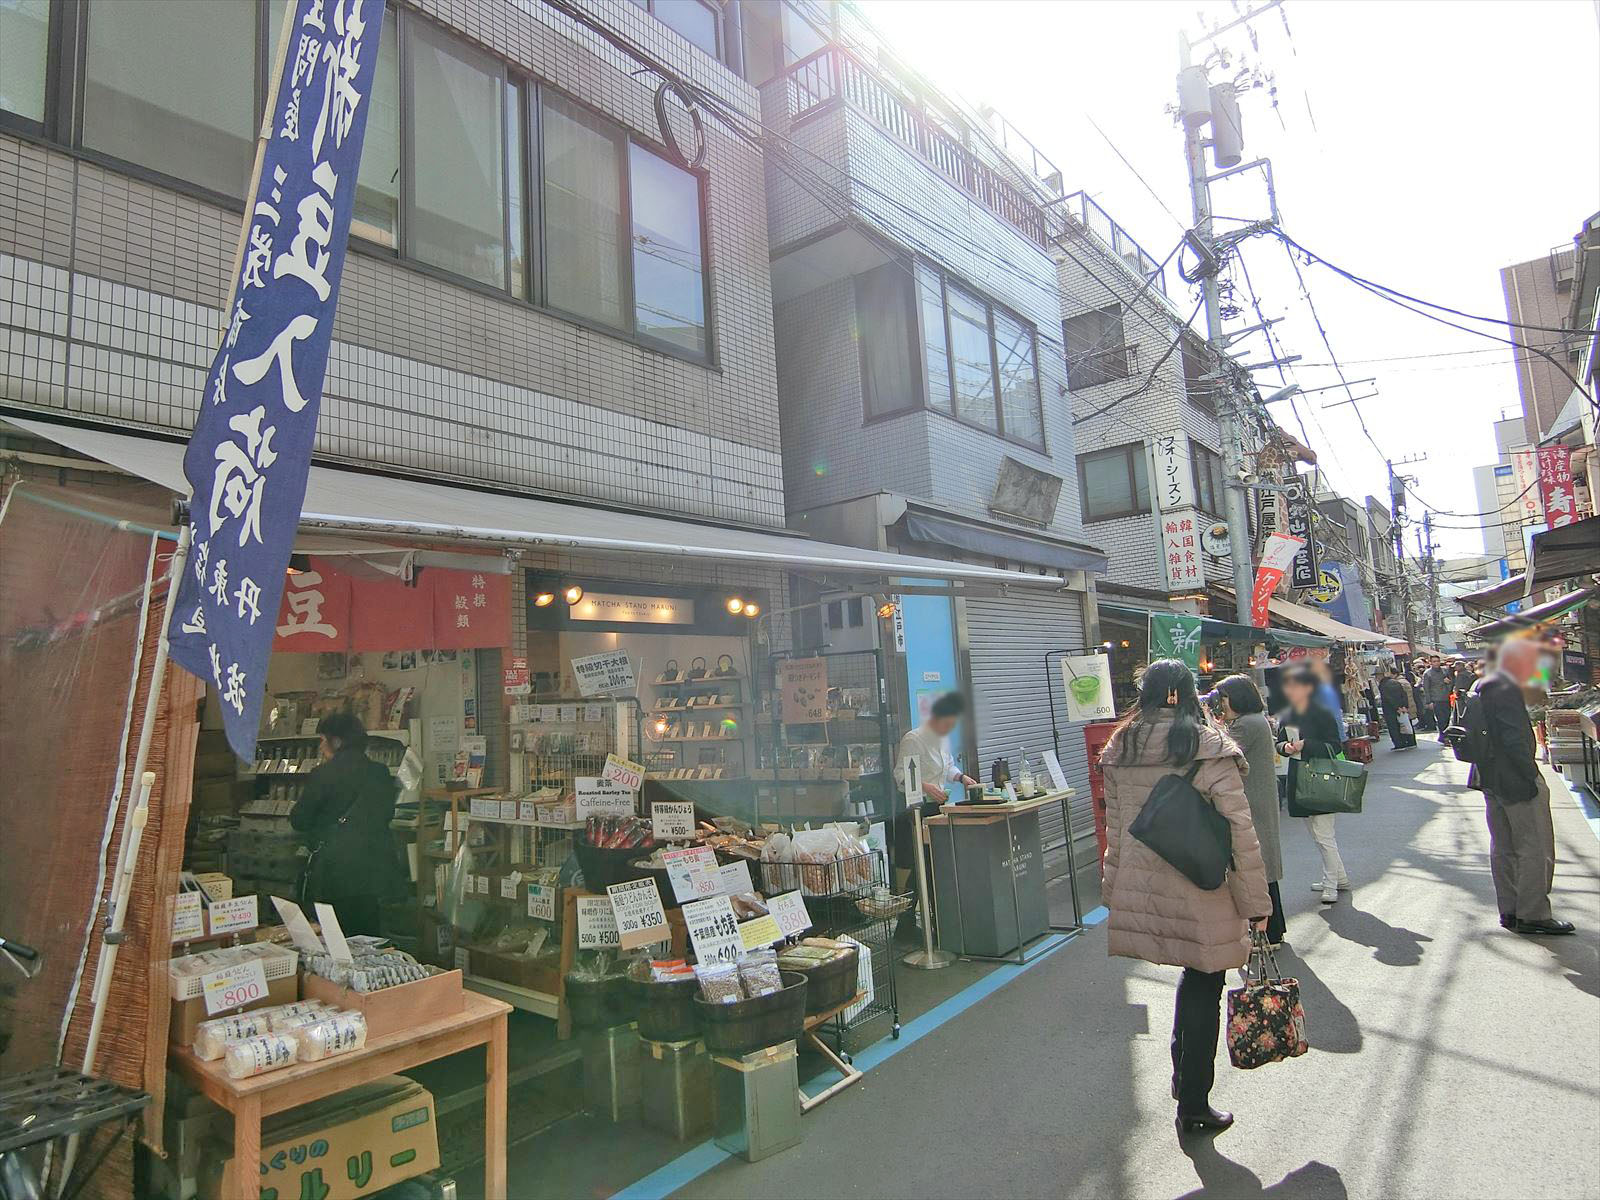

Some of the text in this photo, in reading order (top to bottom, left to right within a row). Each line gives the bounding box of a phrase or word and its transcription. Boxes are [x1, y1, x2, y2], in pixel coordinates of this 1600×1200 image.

[1164, 435, 1181, 506] フォーシーズン
[1552, 448, 1570, 482] 海産物
[1165, 521, 1183, 580] 輸入雑貨
[1179, 519, 1198, 577] 韓国食材
[276, 572, 338, 639] 豆
[592, 600, 621, 608] MATCHA
[625, 602, 647, 610] STAND
[1169, 623, 1202, 655] 新
[580, 797, 630, 807] Caffeine-Free
[621, 920, 638, 931] 300g
[640, 911, 663, 928] ¥350
[783, 910, 807, 931] 380
[581, 931, 620, 944] 500g ¥500
[216, 983, 260, 1010] ¥800
